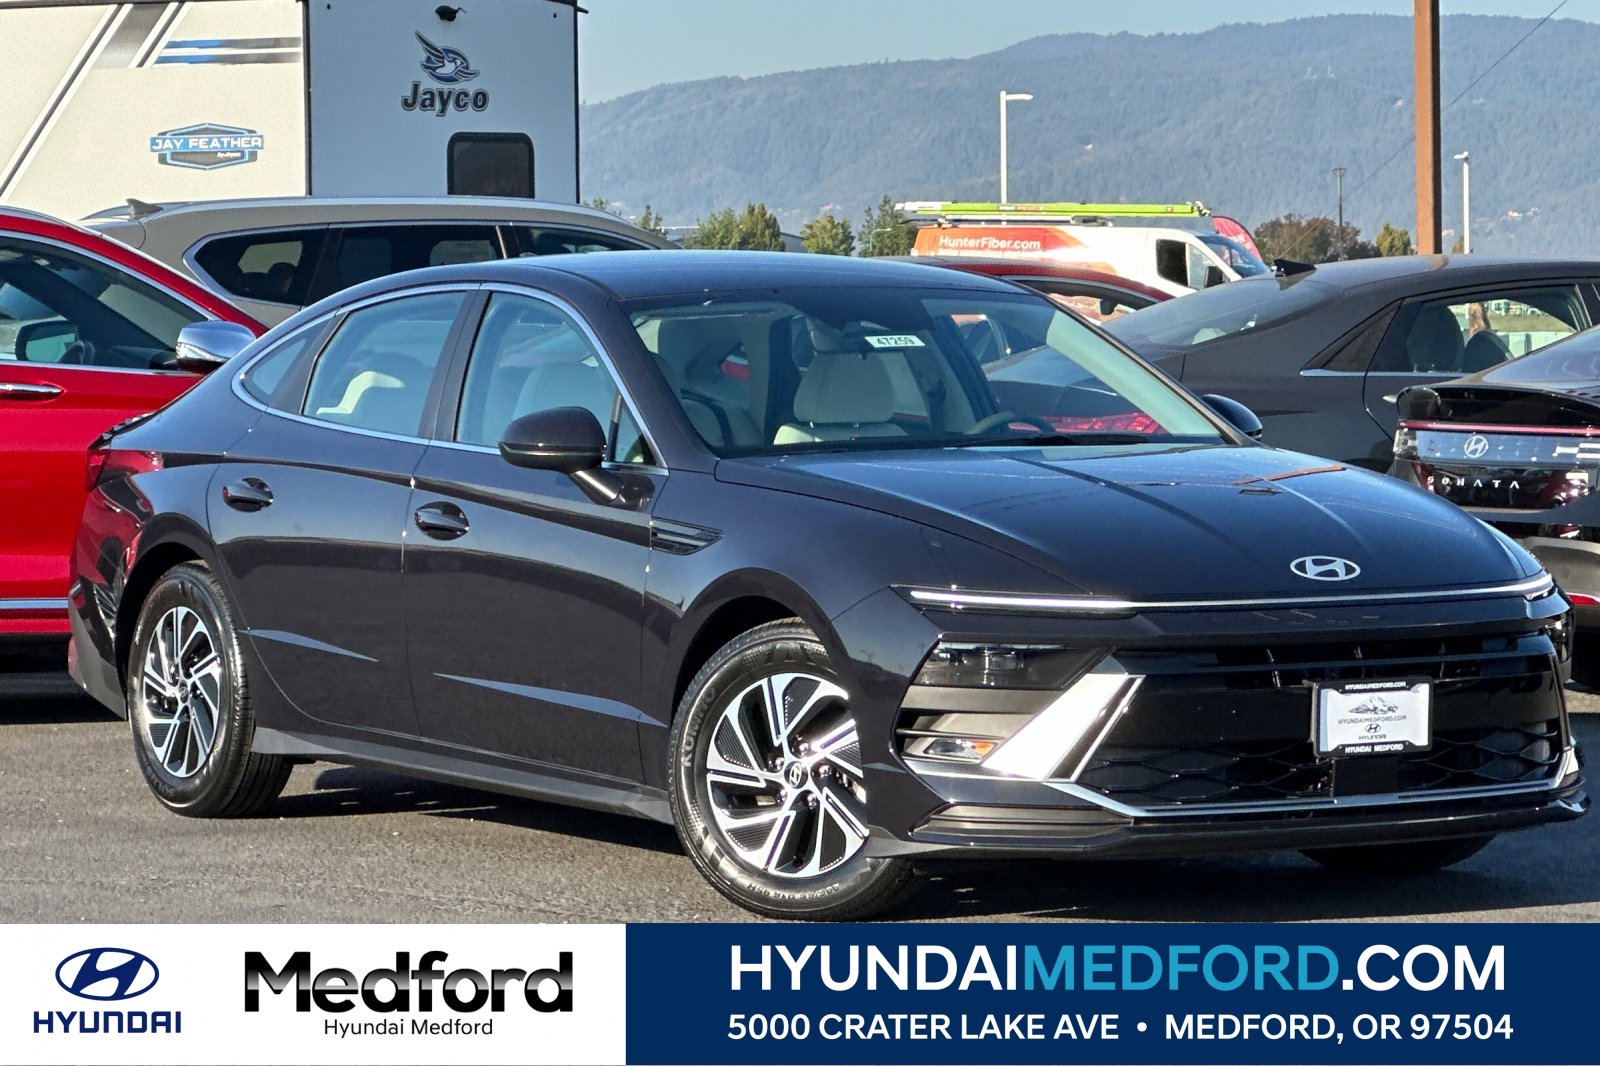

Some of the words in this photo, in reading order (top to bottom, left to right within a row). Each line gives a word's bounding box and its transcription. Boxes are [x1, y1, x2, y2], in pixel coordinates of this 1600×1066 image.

[401, 81, 489, 117] Jayco
[151, 138, 183, 150] JAY
[188, 136, 262, 149] FEATHER
[938, 234, 1041, 250] HunterFiber.com
[877, 336, 916, 346] 47259
[1427, 475, 1520, 490] SONATA
[1338, 715, 1407, 725] HYUNDAIMEDFORD.COM
[1345, 745, 1372, 754] HYUNDAI
[1374, 743, 1404, 752] MEDFORD
